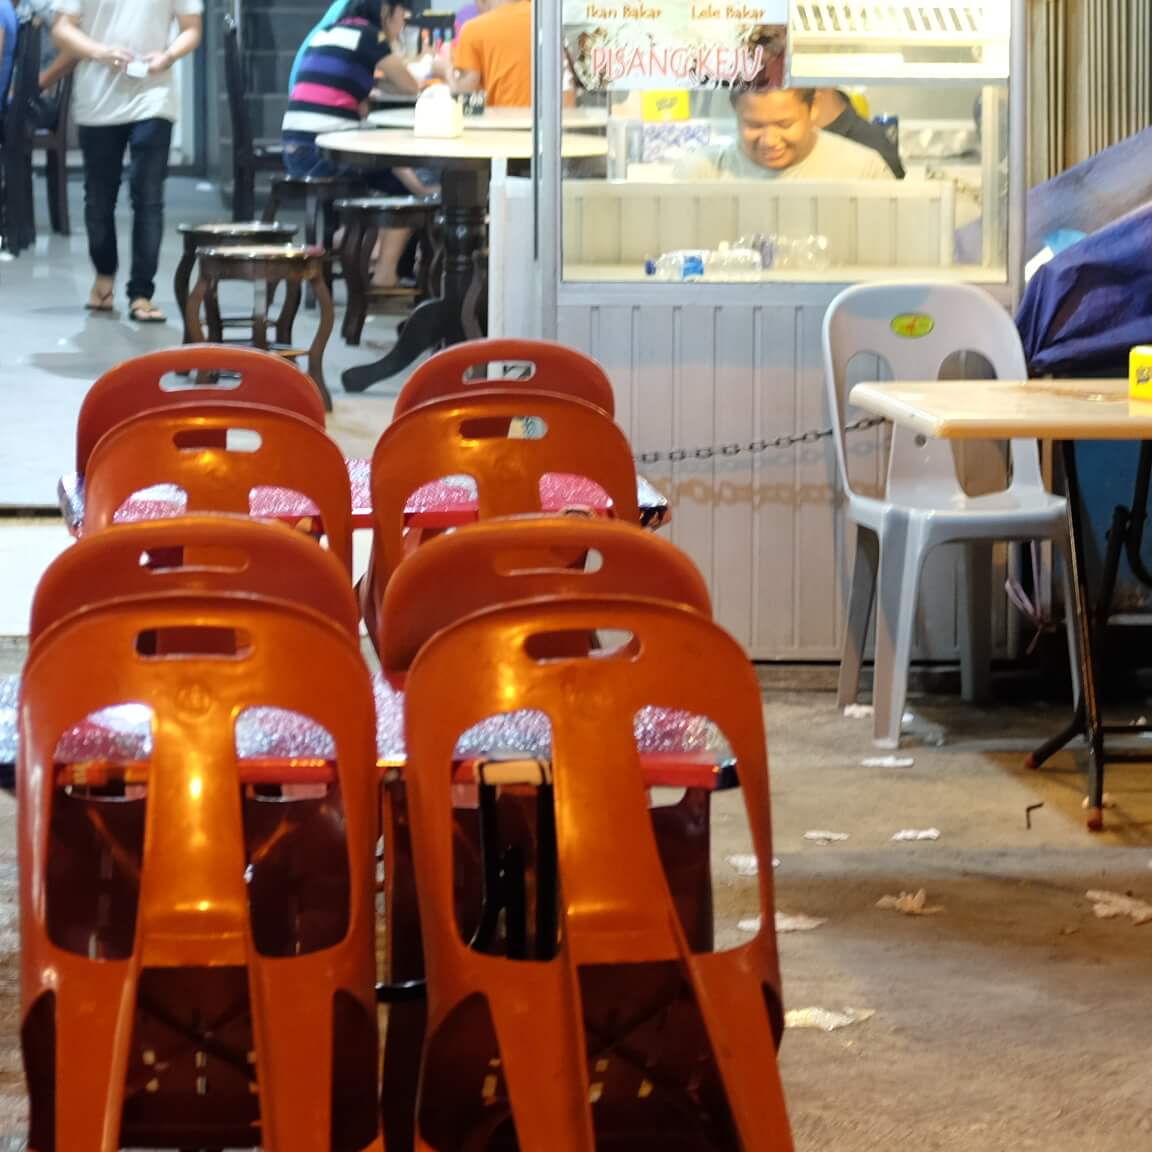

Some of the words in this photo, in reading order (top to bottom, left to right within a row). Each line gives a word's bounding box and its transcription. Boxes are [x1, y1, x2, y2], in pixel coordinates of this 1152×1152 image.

[586, 5, 618, 18] Ikan
[623, 4, 663, 19] Bakar
[691, 4, 721, 19] Lele
[725, 4, 767, 19] Bakar
[591, 46, 690, 81] PISANG
[697, 44, 766, 82] KEJU
